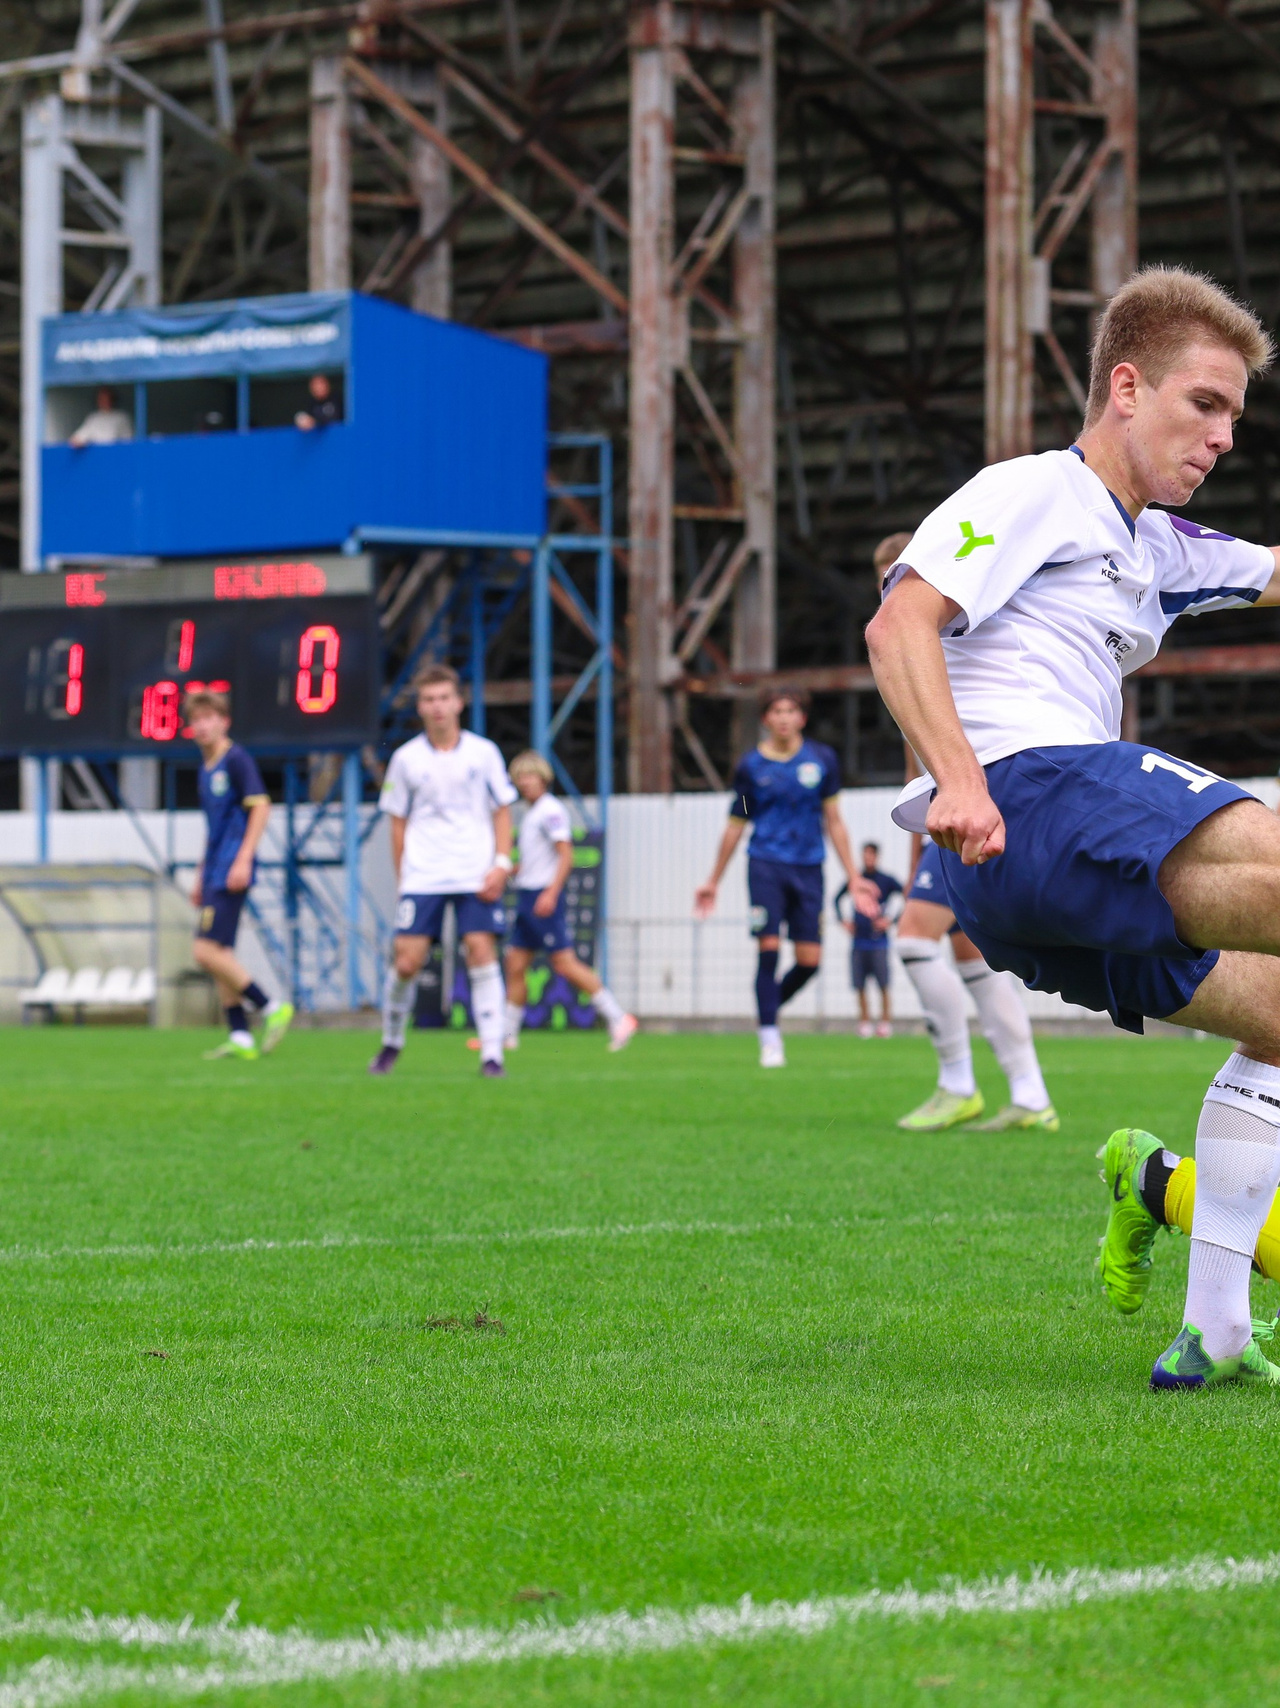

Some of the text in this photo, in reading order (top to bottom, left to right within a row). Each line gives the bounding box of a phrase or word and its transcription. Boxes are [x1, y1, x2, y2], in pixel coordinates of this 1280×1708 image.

[296, 625, 340, 714] 0
[1140, 752, 1228, 794] 1
[1209, 1079, 1255, 1099] ELME
